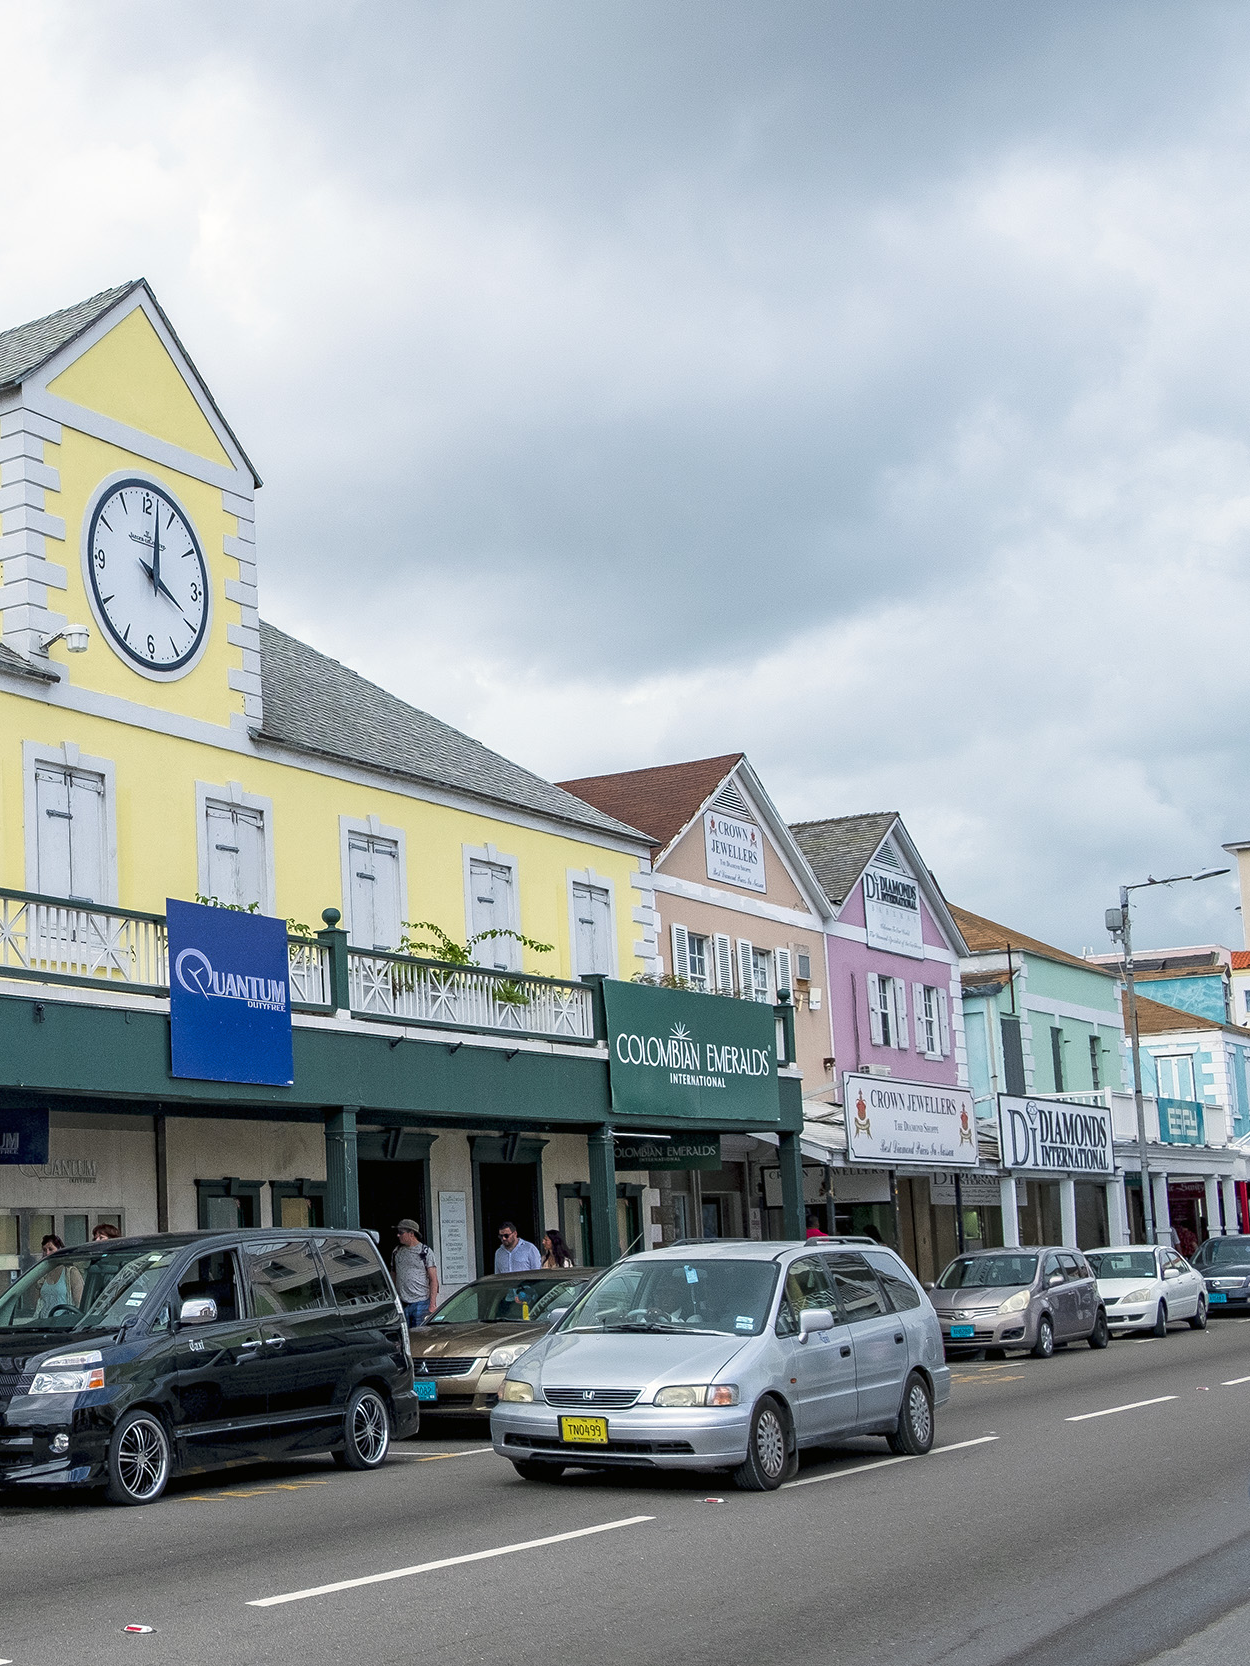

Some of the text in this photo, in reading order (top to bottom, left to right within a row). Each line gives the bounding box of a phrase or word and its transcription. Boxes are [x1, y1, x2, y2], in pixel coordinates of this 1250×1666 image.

[143, 497, 152, 515] 12
[99, 549, 105, 569] 9
[190, 583, 198, 602] 3
[147, 634, 154, 653] 6
[718, 821, 748, 841] CROWN
[712, 839, 758, 865] JEWELLERS
[880, 876, 916, 900] DIAMONDS
[175, 948, 286, 1003] QUANTUM
[616, 1033, 769, 1076] COLOMBIAN EMERALDS
[670, 1072, 726, 1088] INTERNATIONAL
[871, 1089, 957, 1116] CROWN JEWELLERS
[1038, 1109, 1107, 1149] DIAMONDS
[614, 1145, 716, 1158] OLOMBIAN EMERALDS
[1041, 1144, 1109, 1170] INTERNATIONAL
[819, 1166, 886, 1177] JWELLERS
[189, 1339, 205, 1352] Taxi
